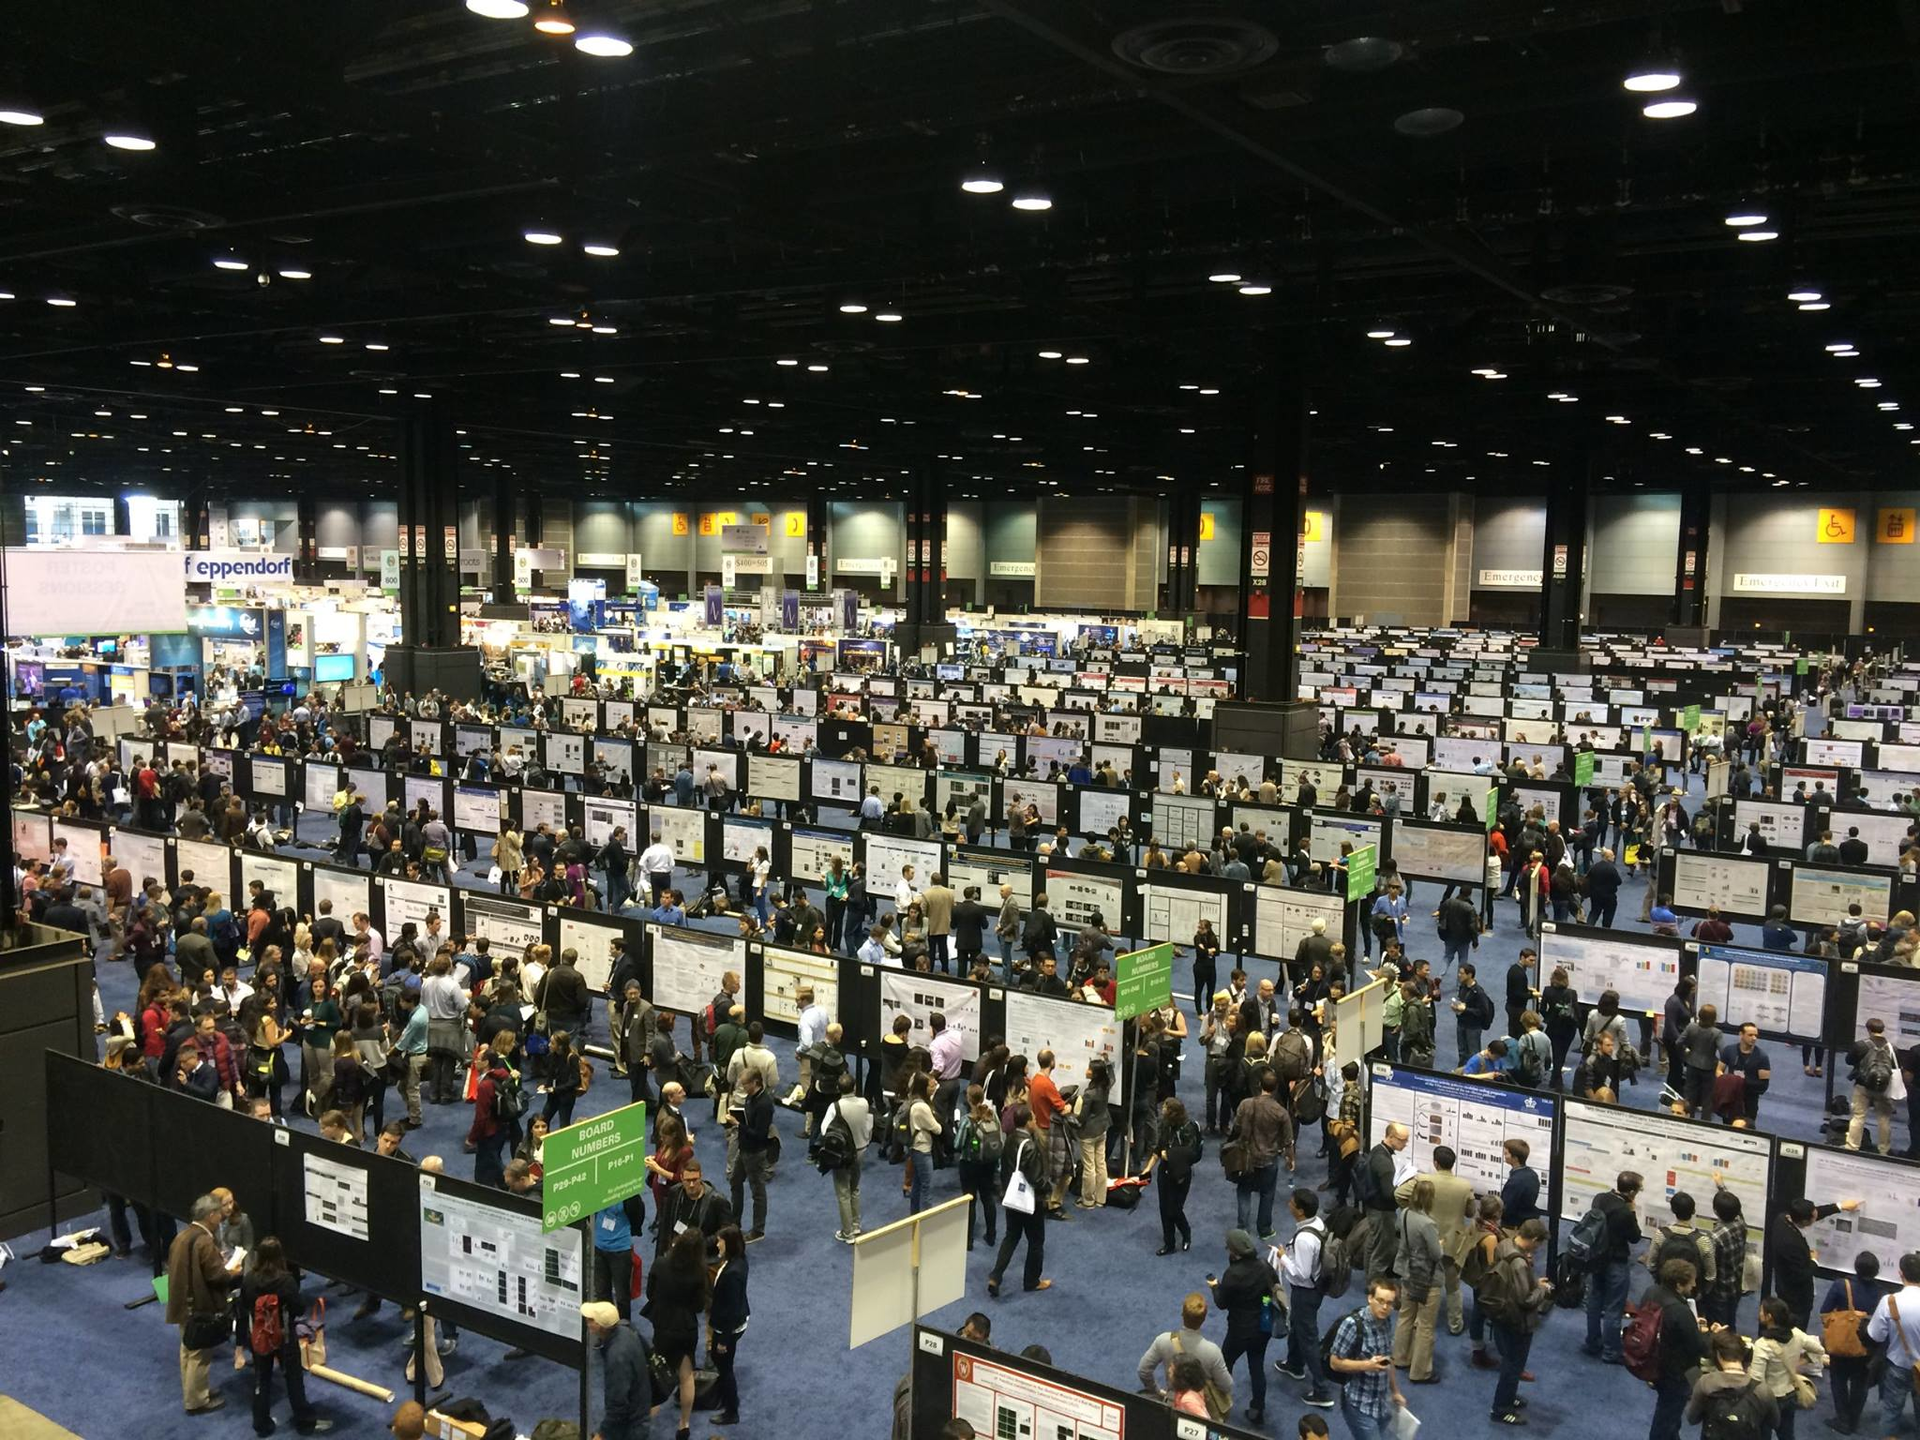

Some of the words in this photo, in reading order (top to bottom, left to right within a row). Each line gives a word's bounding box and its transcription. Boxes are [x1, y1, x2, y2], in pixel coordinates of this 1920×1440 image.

[197, 557, 291, 579] eppendorf
[579, 1120, 614, 1141] BOARD
[571, 1132, 621, 1160] NUMBERS
[553, 1172, 587, 1193] P29-P42
[925, 1339, 938, 1349] P28
[1184, 1426, 1199, 1437] P27
